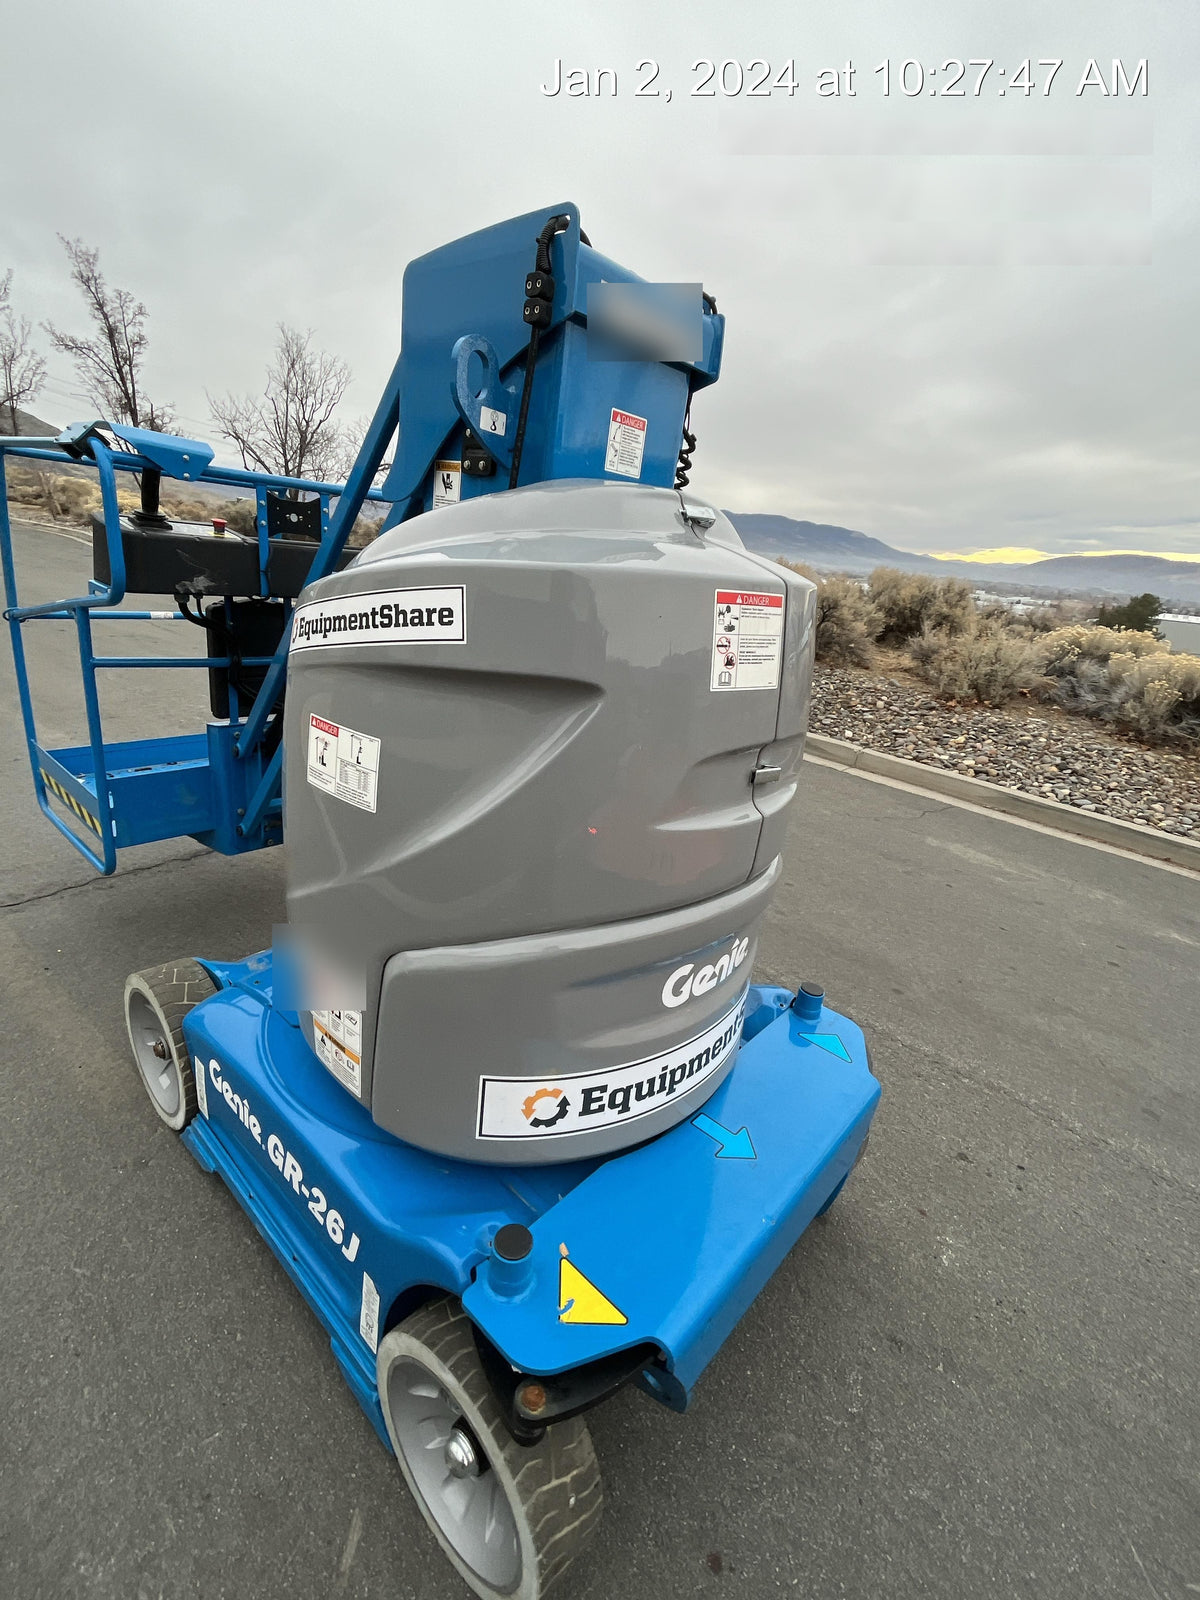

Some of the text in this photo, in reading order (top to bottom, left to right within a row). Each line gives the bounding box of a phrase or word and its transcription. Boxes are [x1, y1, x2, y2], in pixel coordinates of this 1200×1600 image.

[743, 595, 770, 605] DANGER
[298, 603, 454, 640] EquipmentShare
[316, 719, 338, 736] DANGER
[661, 936, 748, 1008] Genie
[208, 1058, 264, 1146] Genie
[267, 1134, 361, 1263] GR-26J
